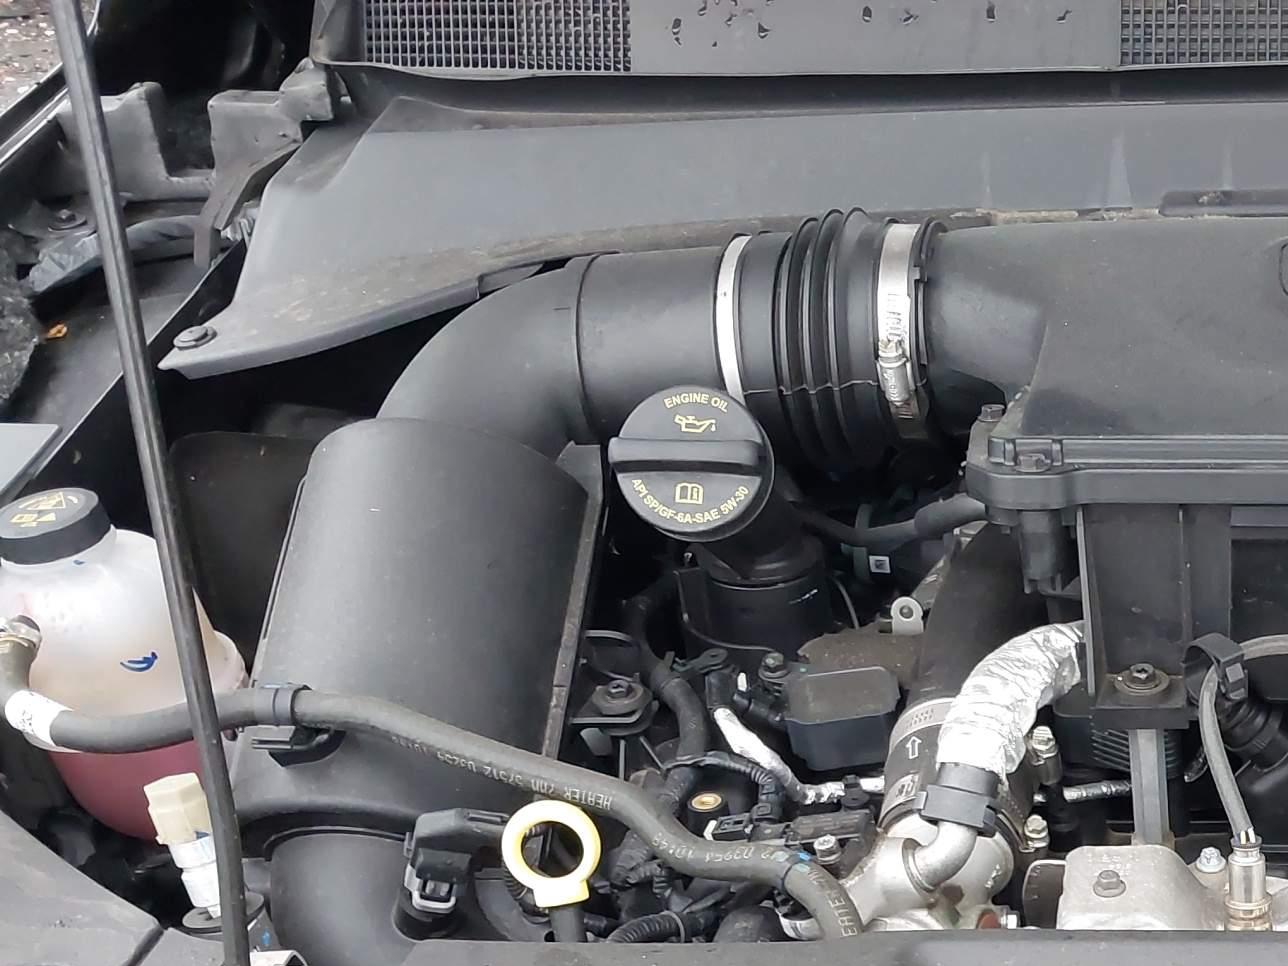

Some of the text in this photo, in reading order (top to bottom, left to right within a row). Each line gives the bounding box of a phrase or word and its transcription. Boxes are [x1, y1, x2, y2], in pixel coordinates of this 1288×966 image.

[664, 392, 729, 412] ENGINE OIL
[631, 478, 649, 497] API
[720, 485, 749, 515] 5W-30
[561, 783, 613, 810] HEATER
